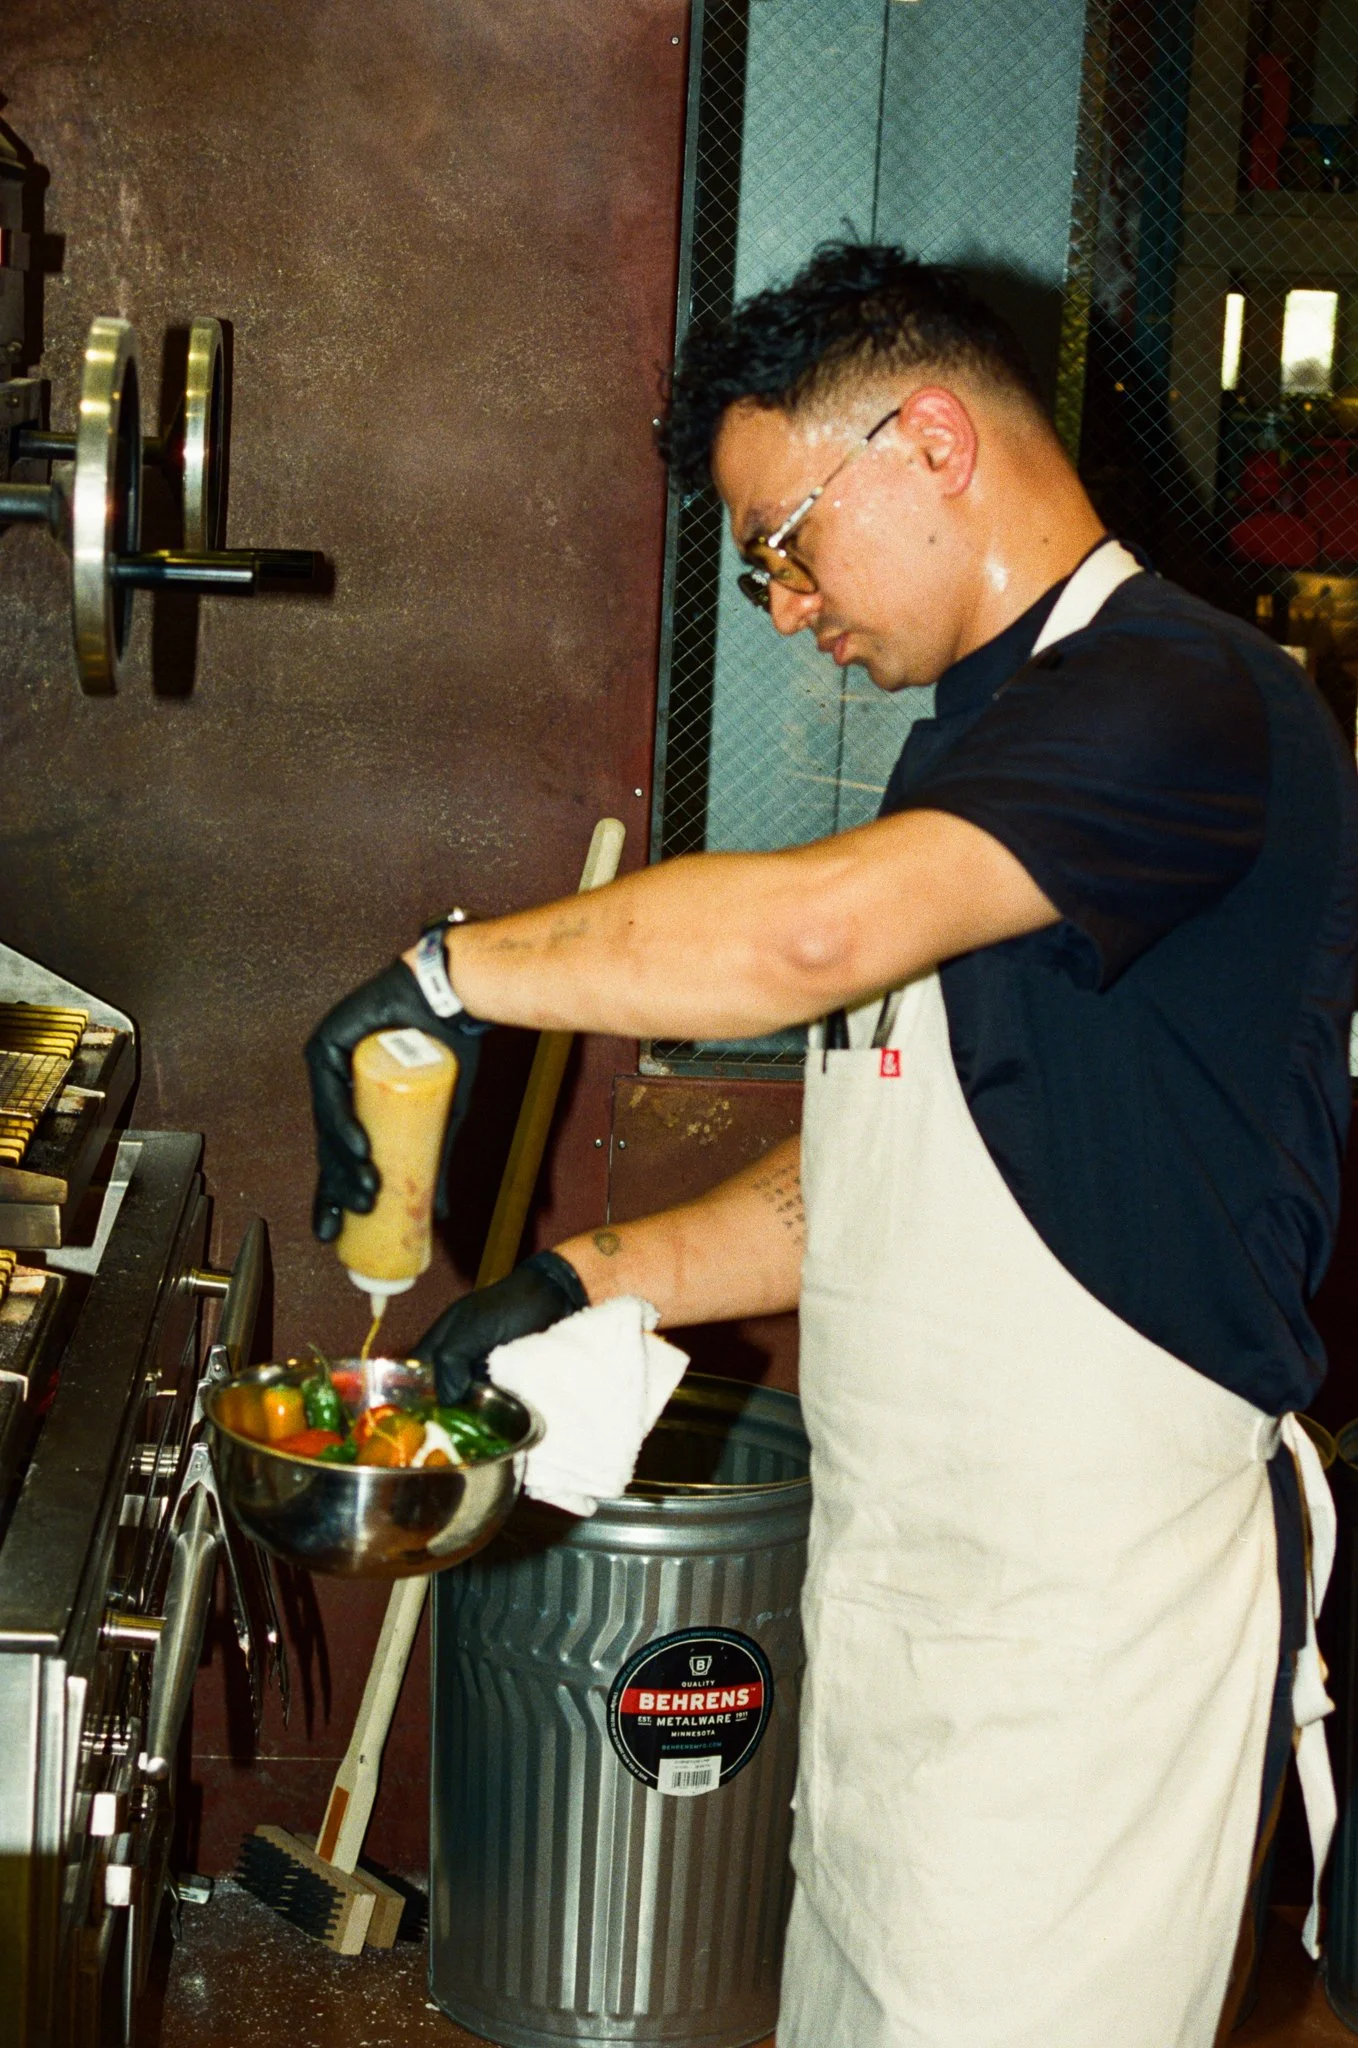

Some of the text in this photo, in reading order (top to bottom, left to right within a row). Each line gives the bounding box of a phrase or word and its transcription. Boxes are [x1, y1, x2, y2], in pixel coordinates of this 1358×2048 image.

[696, 1659, 705, 1671] B
[681, 1680, 715, 1688] QUALITY
[639, 1688, 750, 1711] BEHRENS
[656, 1714, 732, 1727] METALWARE
[671, 1730, 716, 1738] MINNESOTA
